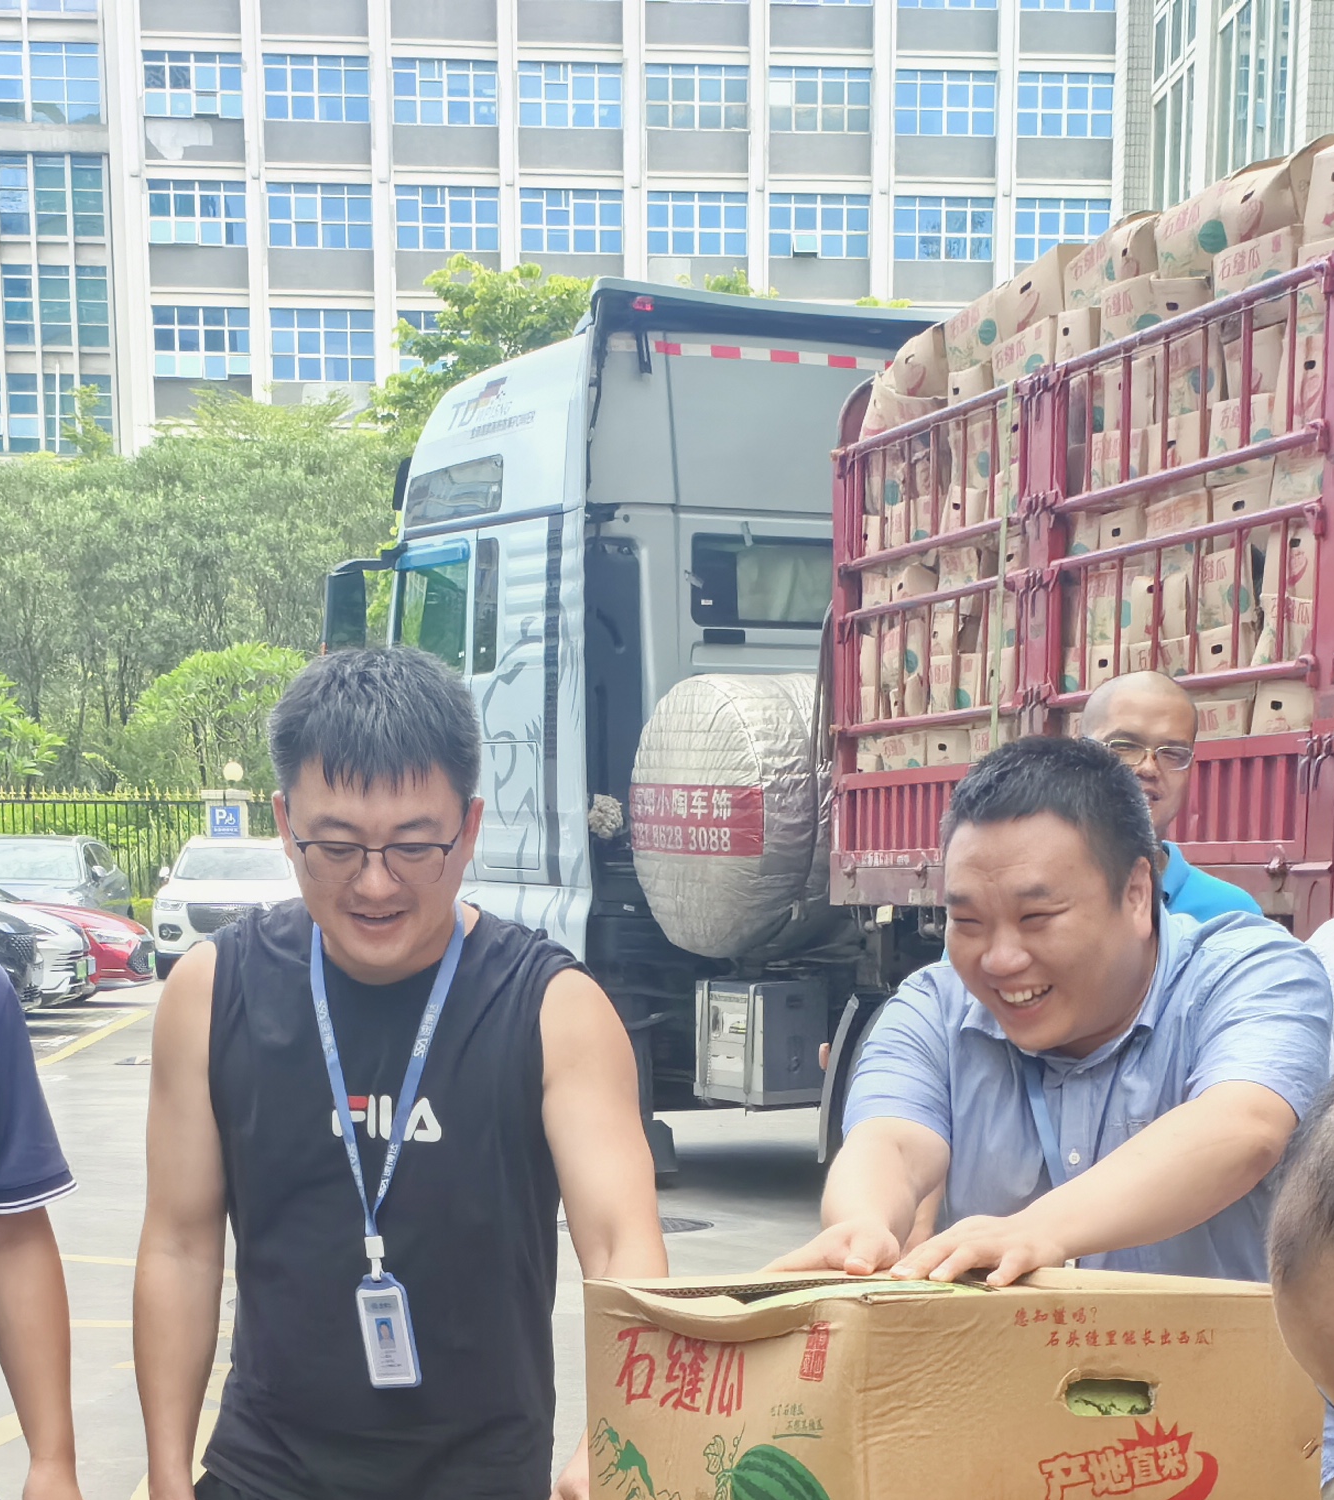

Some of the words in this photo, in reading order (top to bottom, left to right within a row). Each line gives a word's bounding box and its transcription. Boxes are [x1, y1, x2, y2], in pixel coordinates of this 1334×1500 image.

[653, 825, 682, 849] 8628
[688, 826, 730, 852] 3088
[331, 1094, 442, 1142] FILA
[615, 1325, 745, 1418] 石缝瓜
